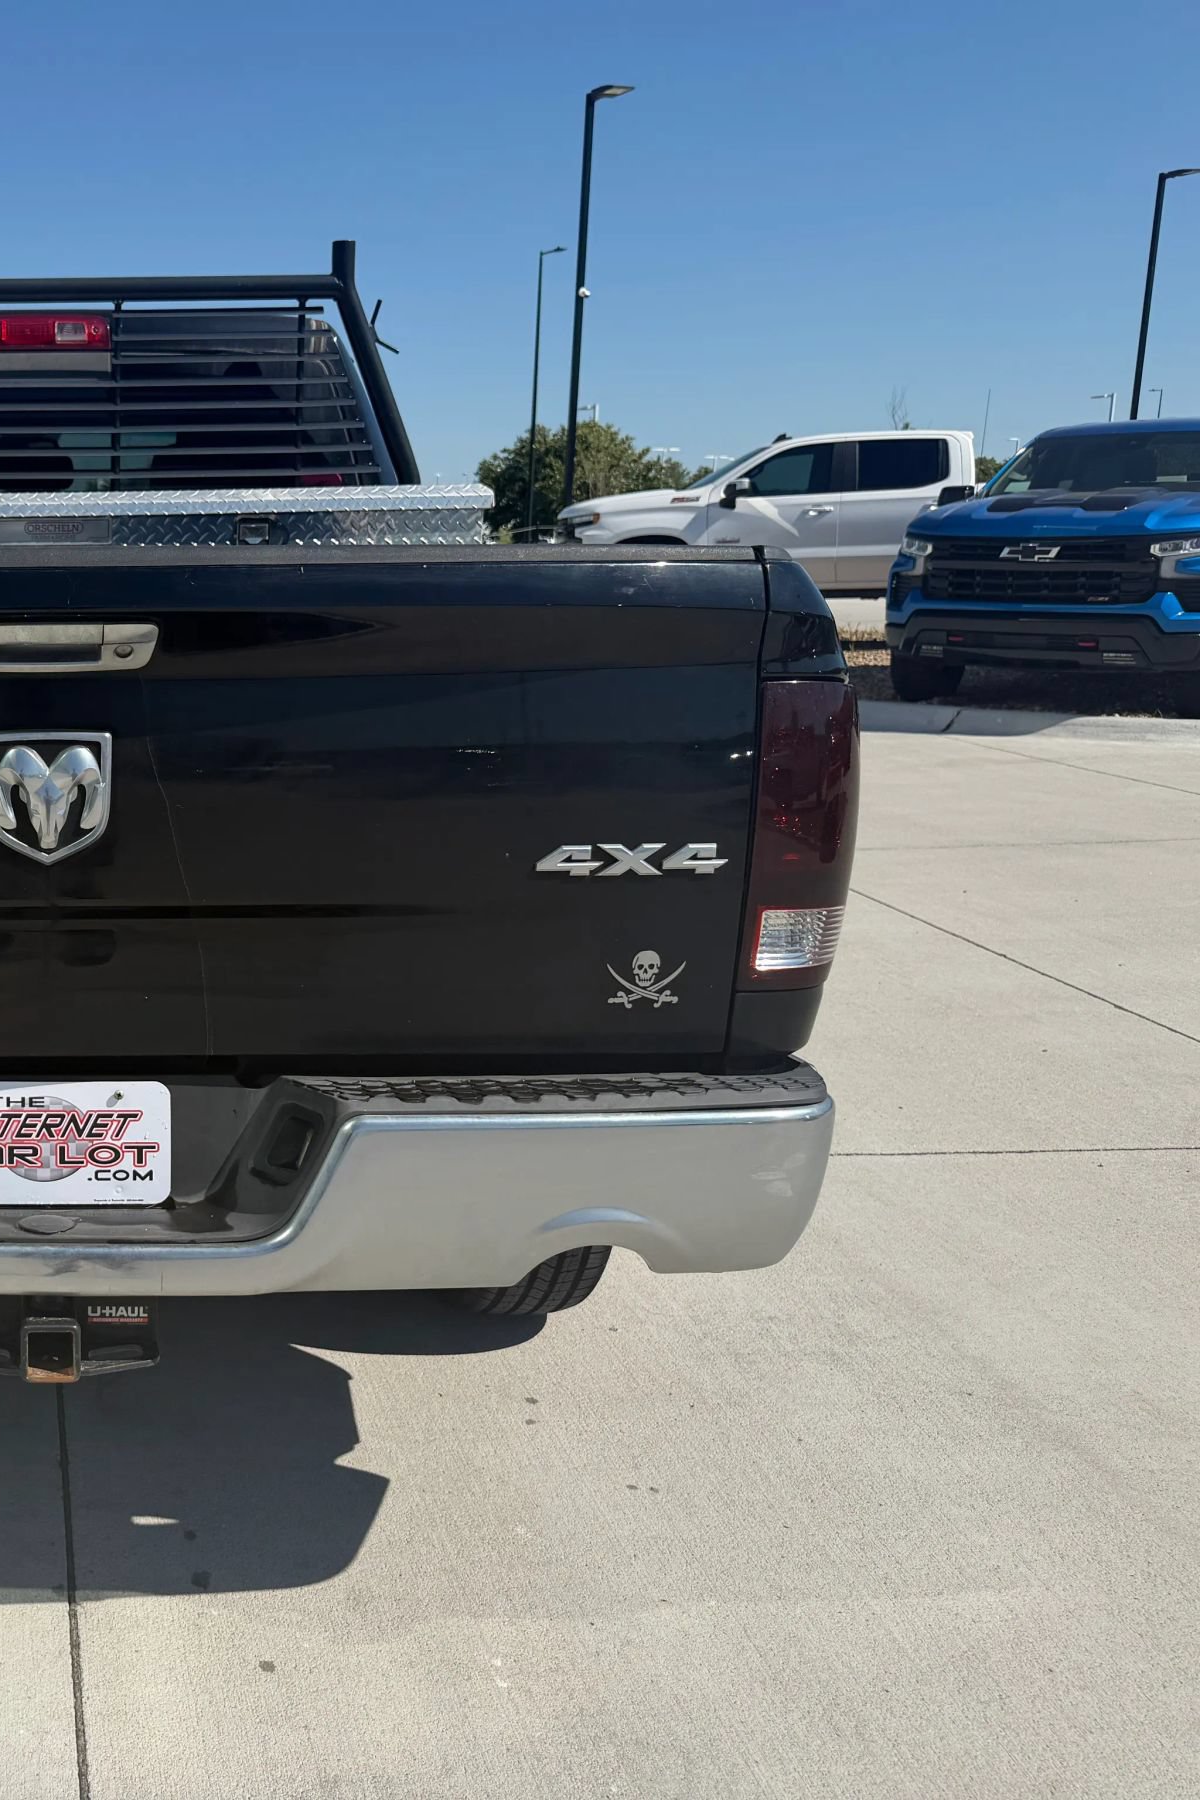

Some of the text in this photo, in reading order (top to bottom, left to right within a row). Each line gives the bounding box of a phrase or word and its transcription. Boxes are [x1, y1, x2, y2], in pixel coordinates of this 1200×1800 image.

[535, 842, 729, 876] 4X4
[56, 1142, 160, 1168] LOT
[87, 1169, 154, 1182] .COM
[87, 1305, 148, 1317] U-HAUL
